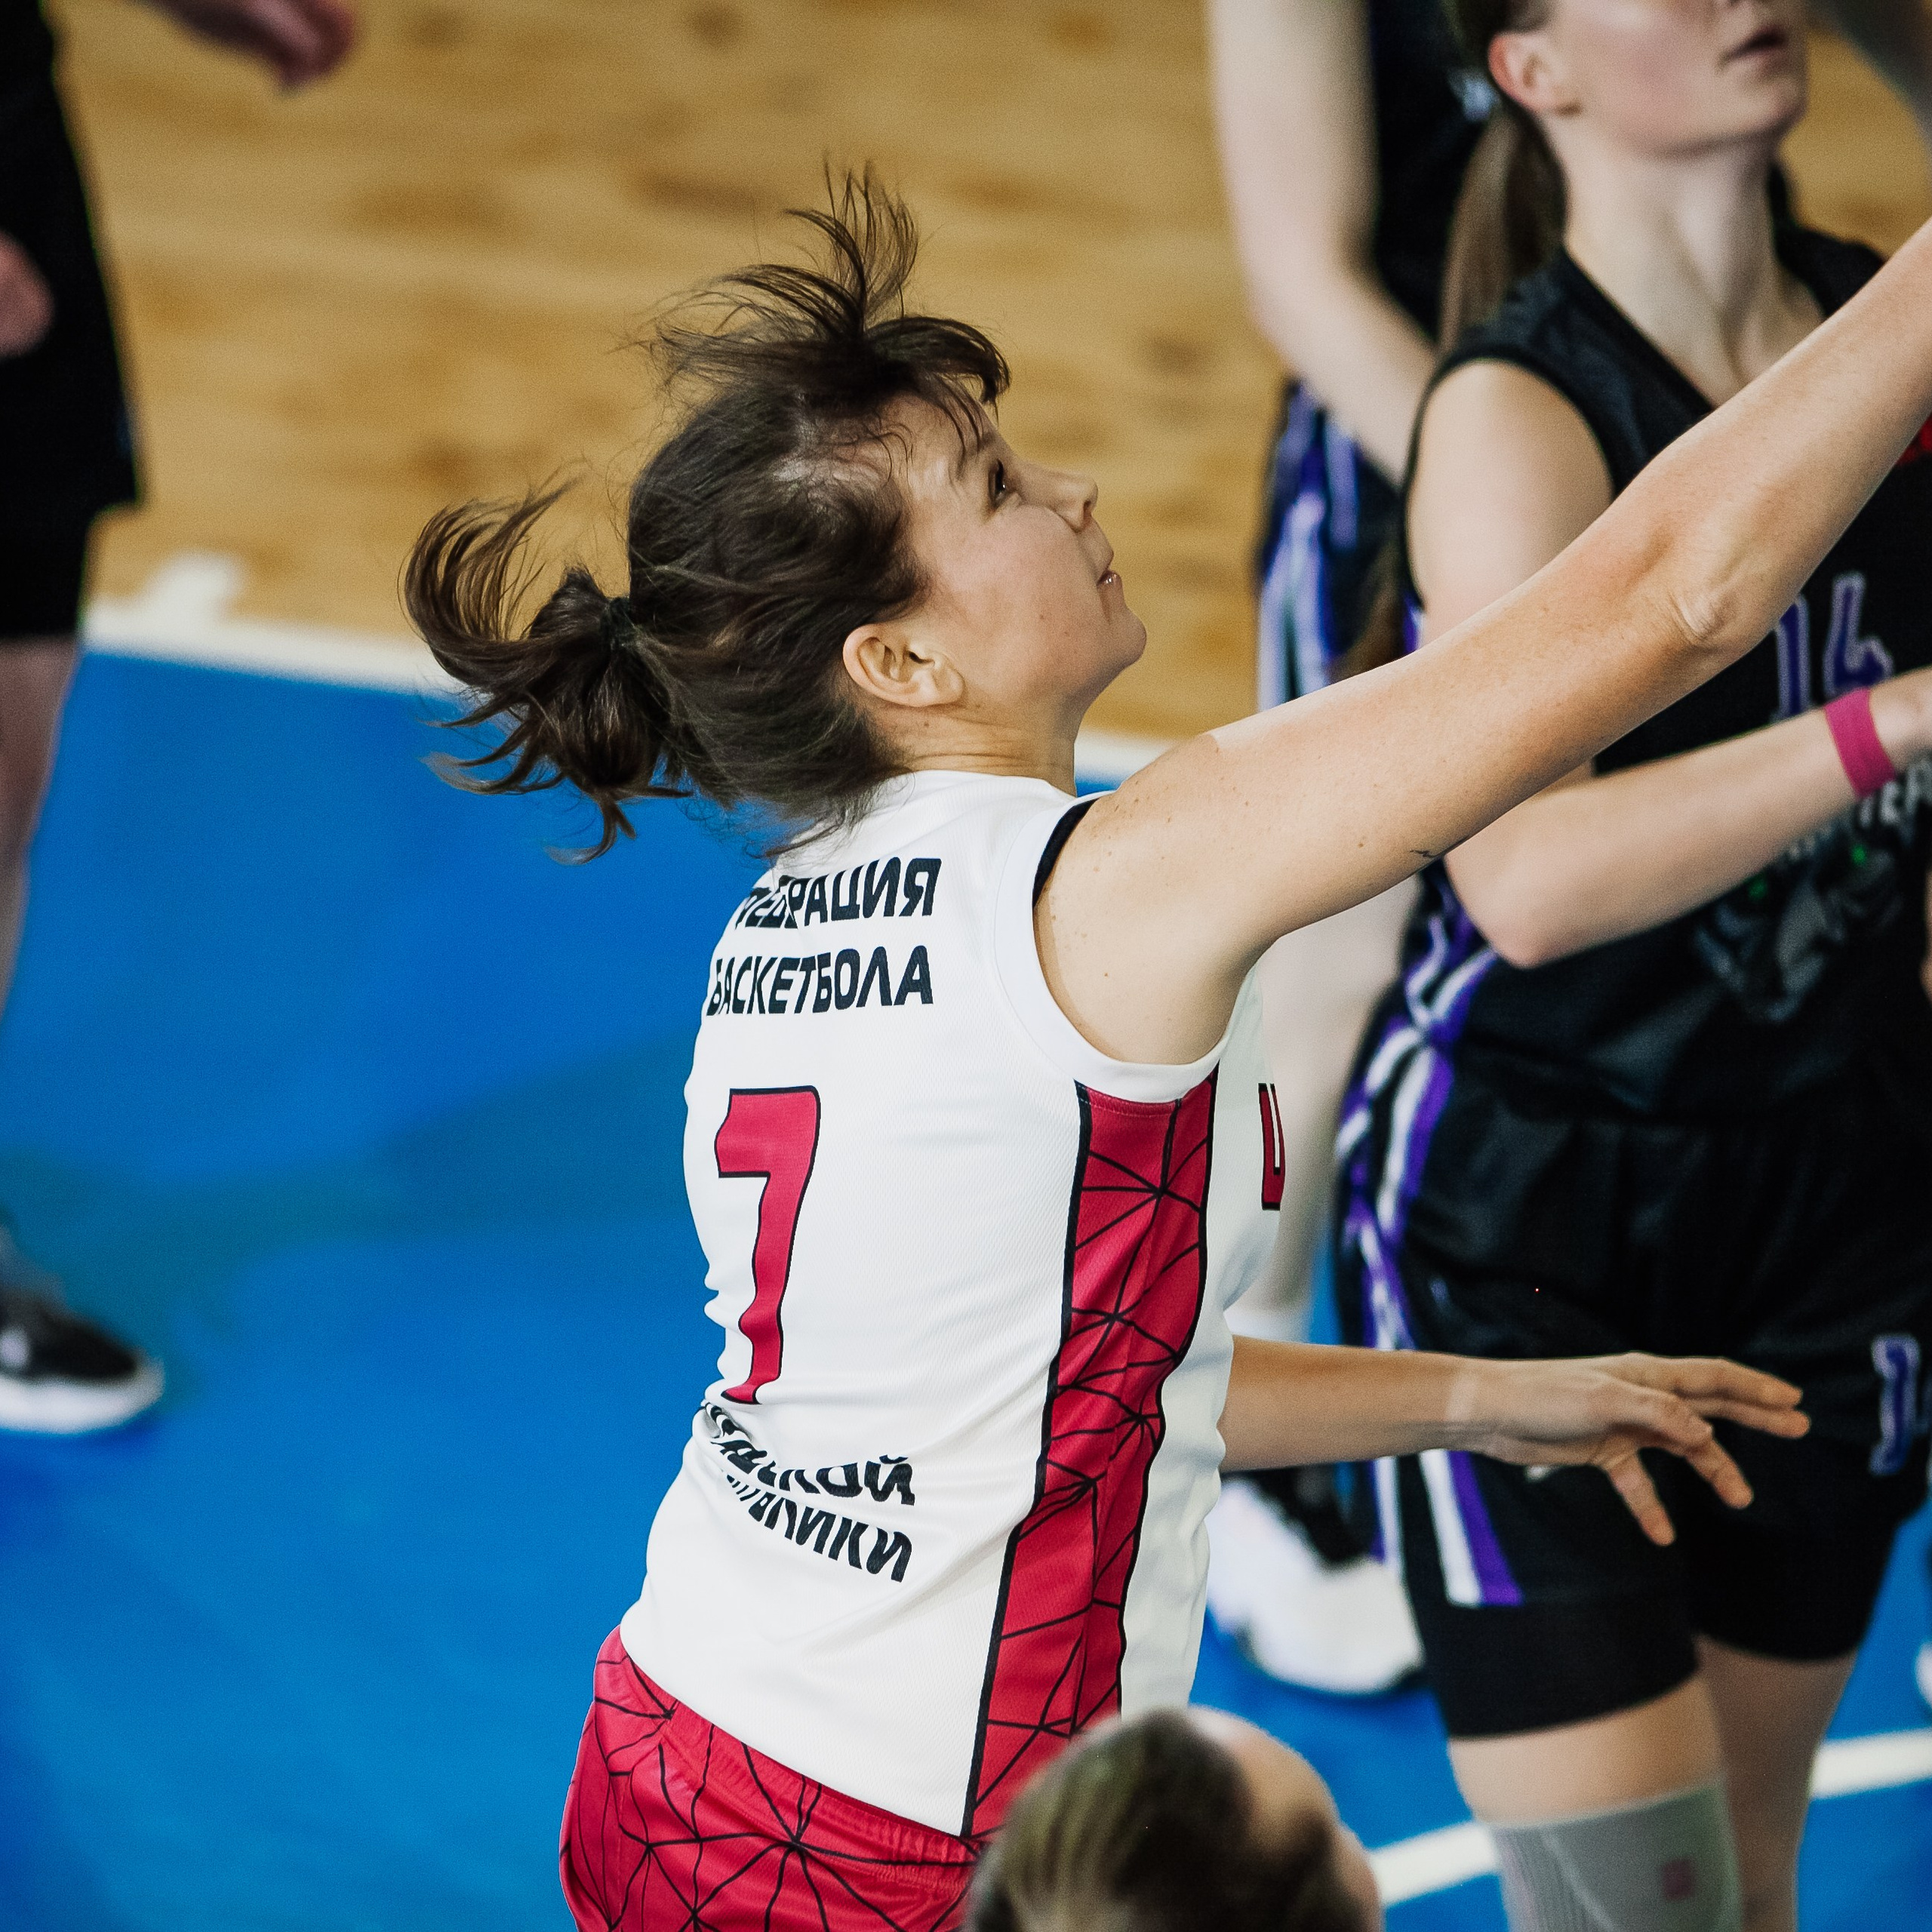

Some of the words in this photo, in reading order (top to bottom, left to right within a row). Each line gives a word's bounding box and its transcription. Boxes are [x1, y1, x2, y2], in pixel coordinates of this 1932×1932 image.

[1769, 571, 1895, 721] 14
[706, 945, 934, 1017] БАСКЕТБОЛА
[714, 1085, 821, 1405] 7
